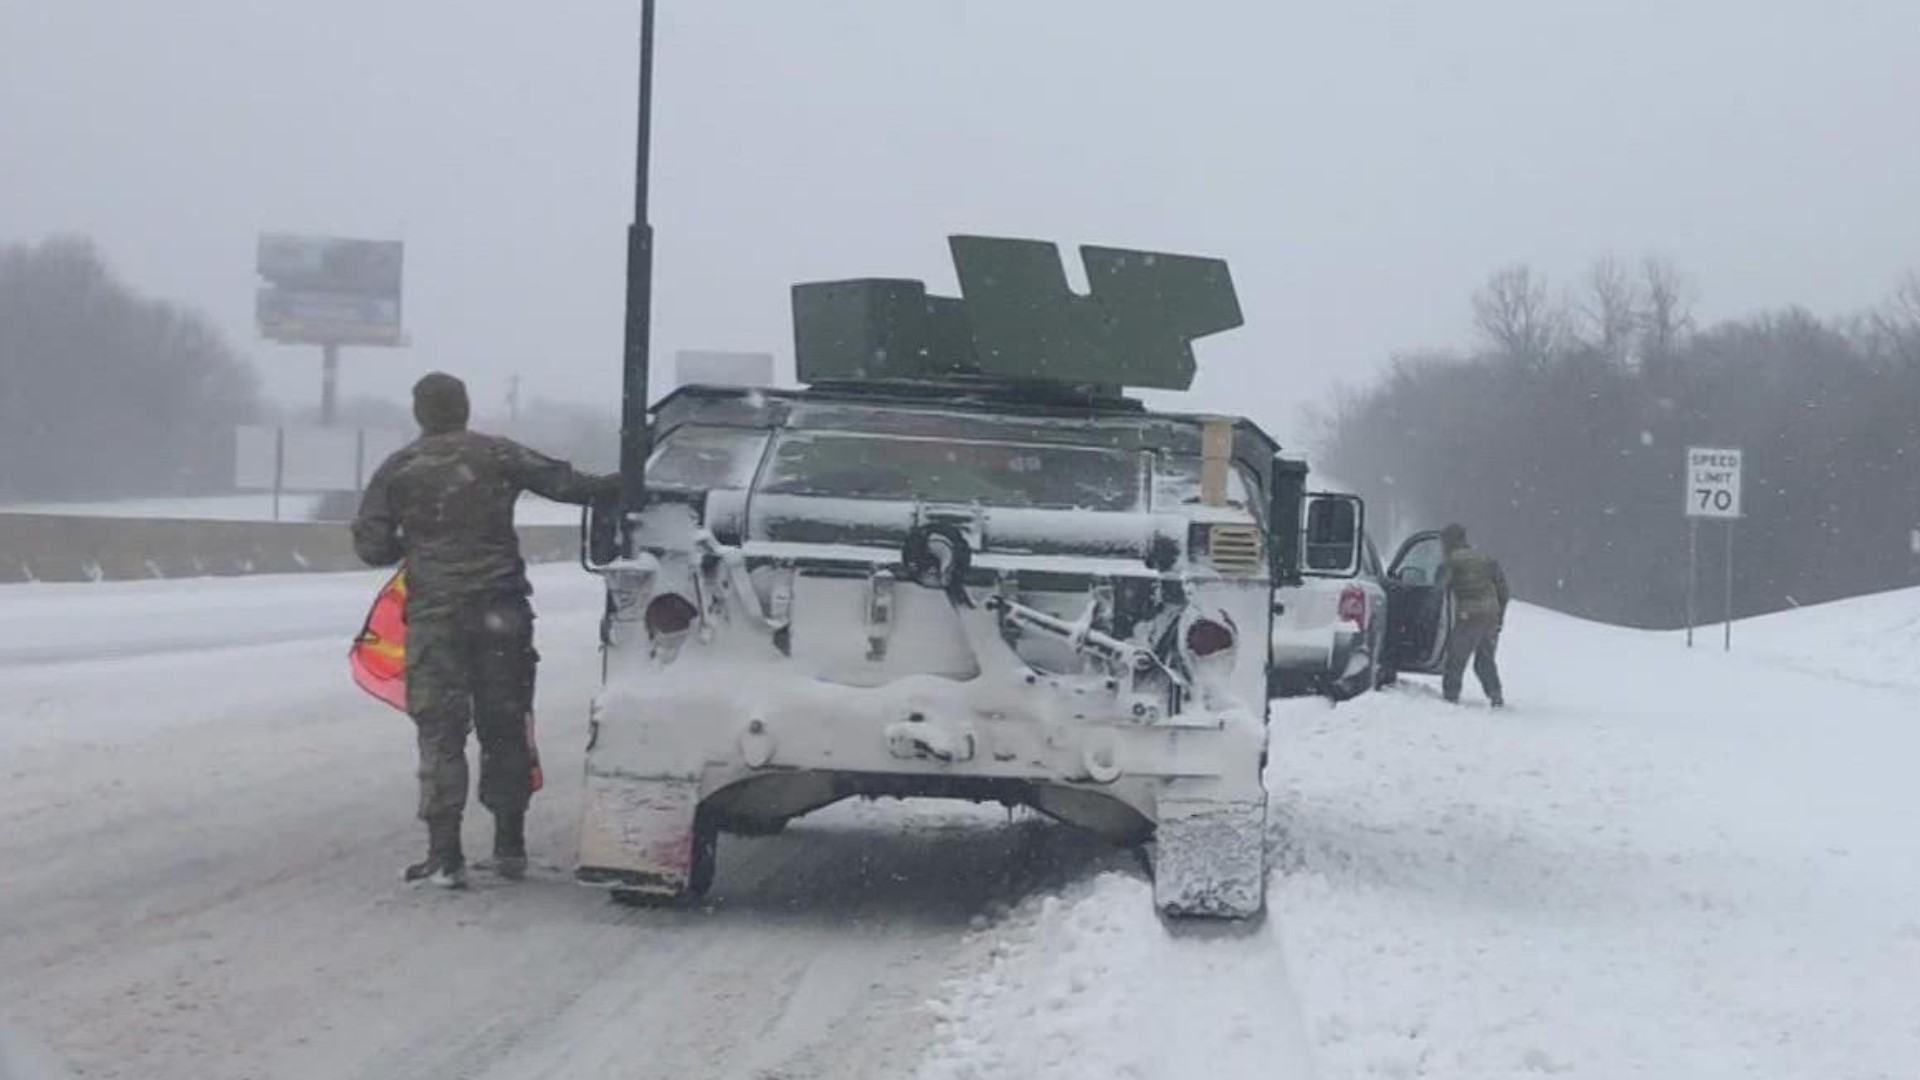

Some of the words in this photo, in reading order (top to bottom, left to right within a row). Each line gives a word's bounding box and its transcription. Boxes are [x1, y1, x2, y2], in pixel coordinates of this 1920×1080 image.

[1692, 454, 1737, 467] SPEED
[1695, 472, 1732, 483] LIMIT
[1695, 488, 1732, 511] 70
